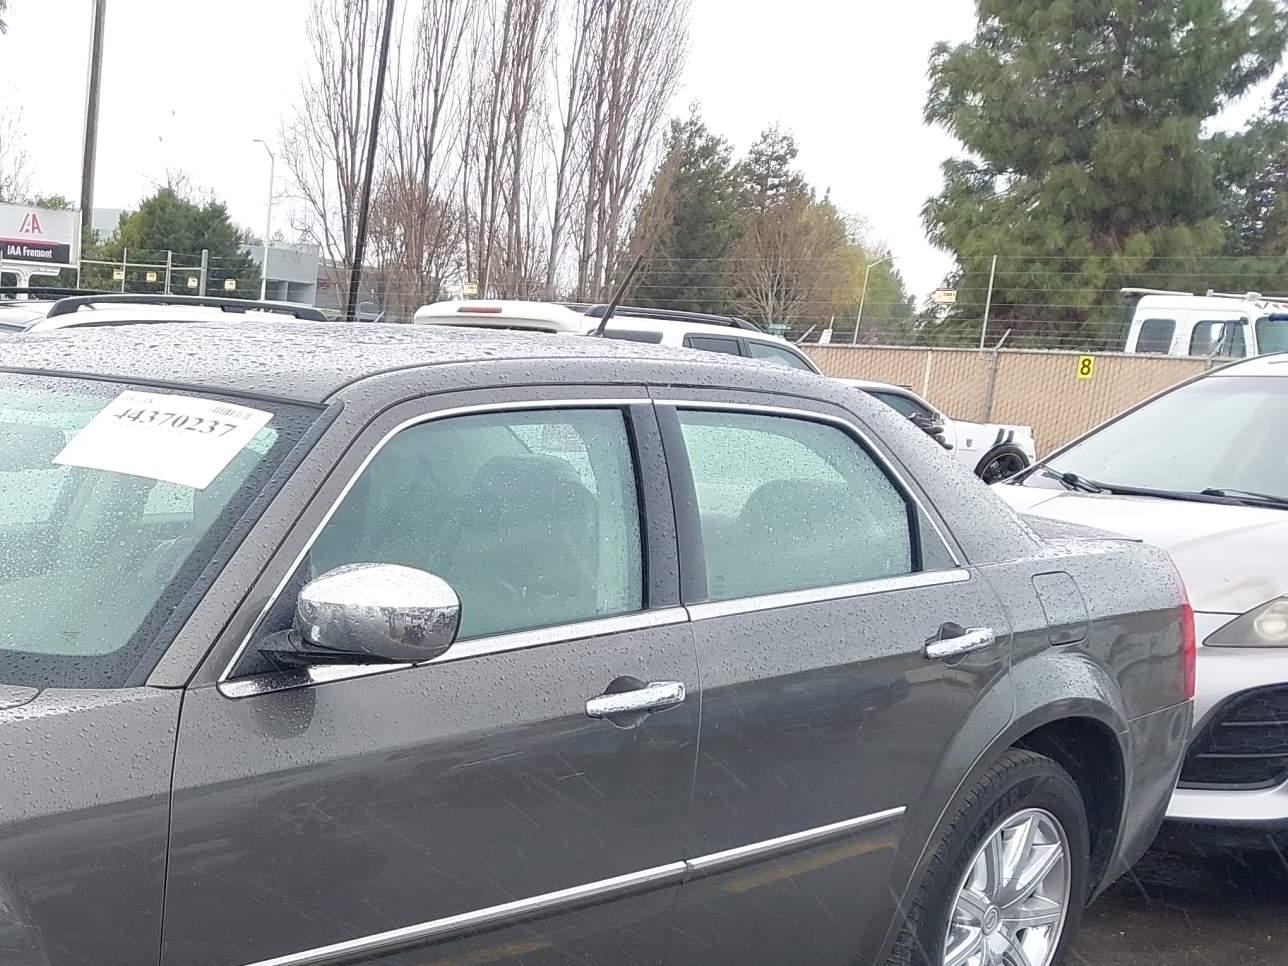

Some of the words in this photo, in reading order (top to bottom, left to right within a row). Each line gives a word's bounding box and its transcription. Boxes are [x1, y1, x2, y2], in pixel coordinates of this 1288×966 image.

[7, 244, 22, 256] IAA
[23, 246, 53, 258] Fremont
[1080, 358, 1092, 376] 8
